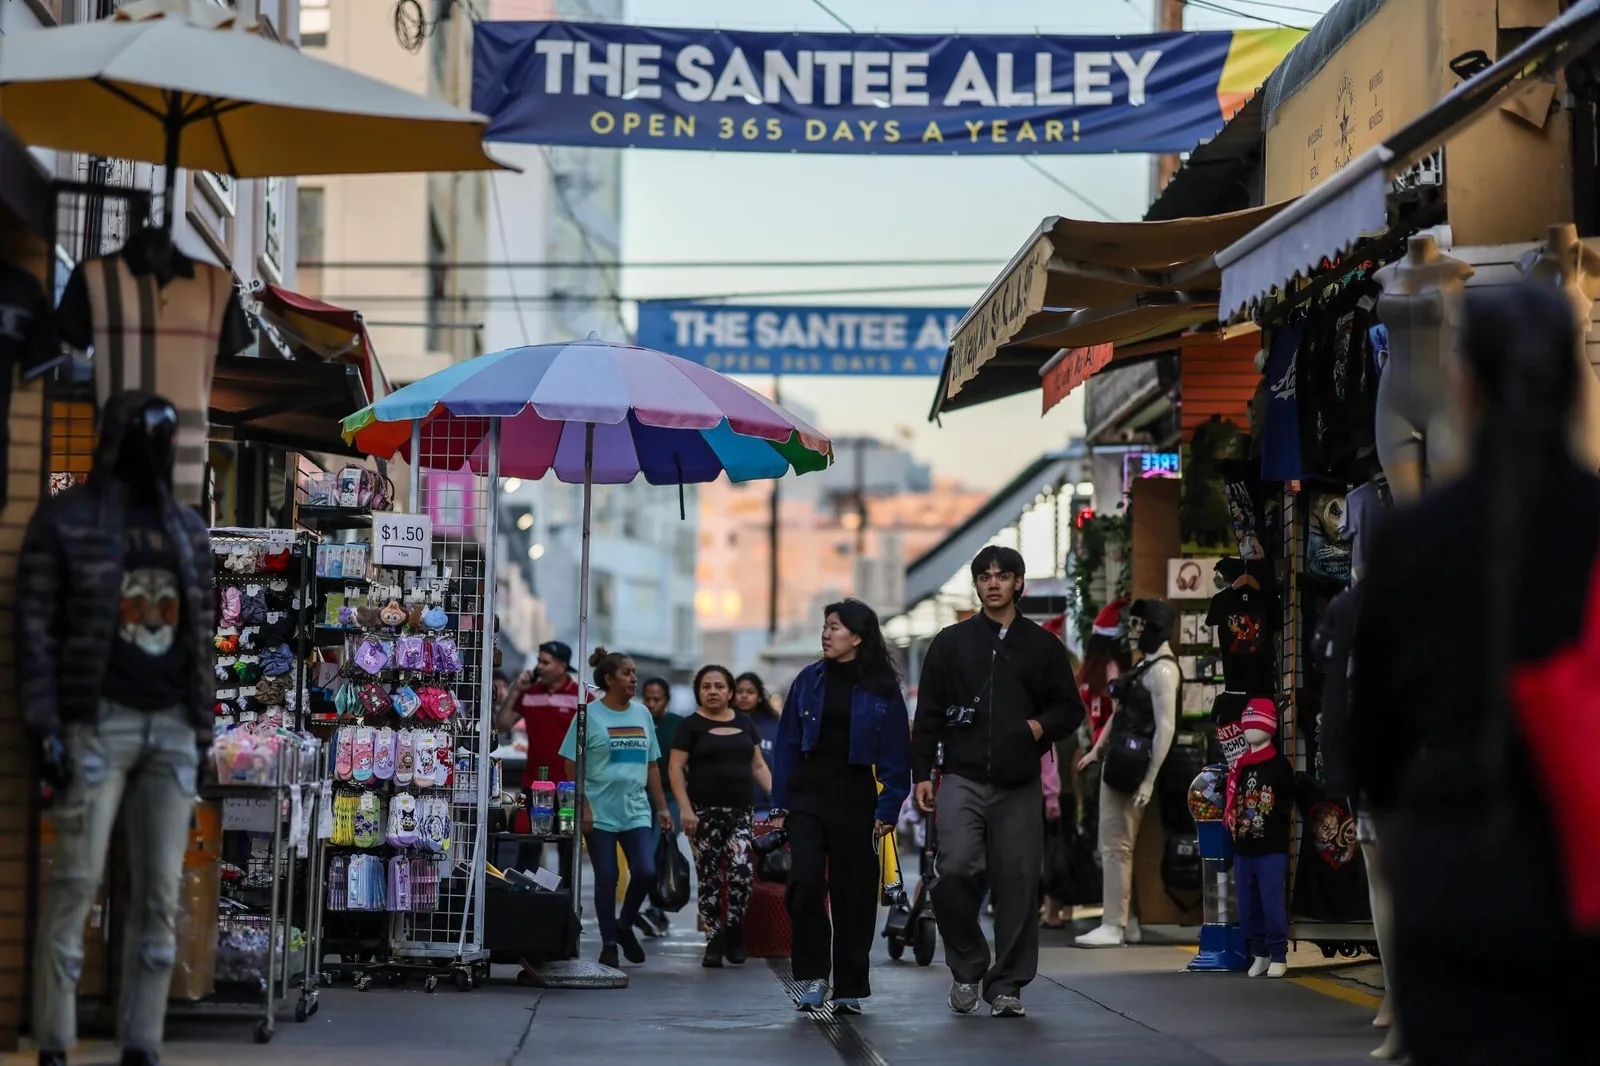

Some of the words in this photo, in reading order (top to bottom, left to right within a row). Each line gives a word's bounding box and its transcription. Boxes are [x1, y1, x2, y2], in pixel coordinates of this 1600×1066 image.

[535, 39, 662, 99] THE
[675, 45, 930, 106] SANTEE
[943, 50, 1163, 106] ALLEY
[590, 111, 695, 137] OPEN
[718, 117, 783, 140] 365
[805, 119, 901, 142] DAYS
[922, 121, 944, 142] A
[965, 120, 1081, 143] YEAR!
[671, 310, 749, 347] THE
[755, 312, 909, 349] SANTEE
[705, 352, 770, 371] OPEN
[381, 523, 424, 542] $1.50
